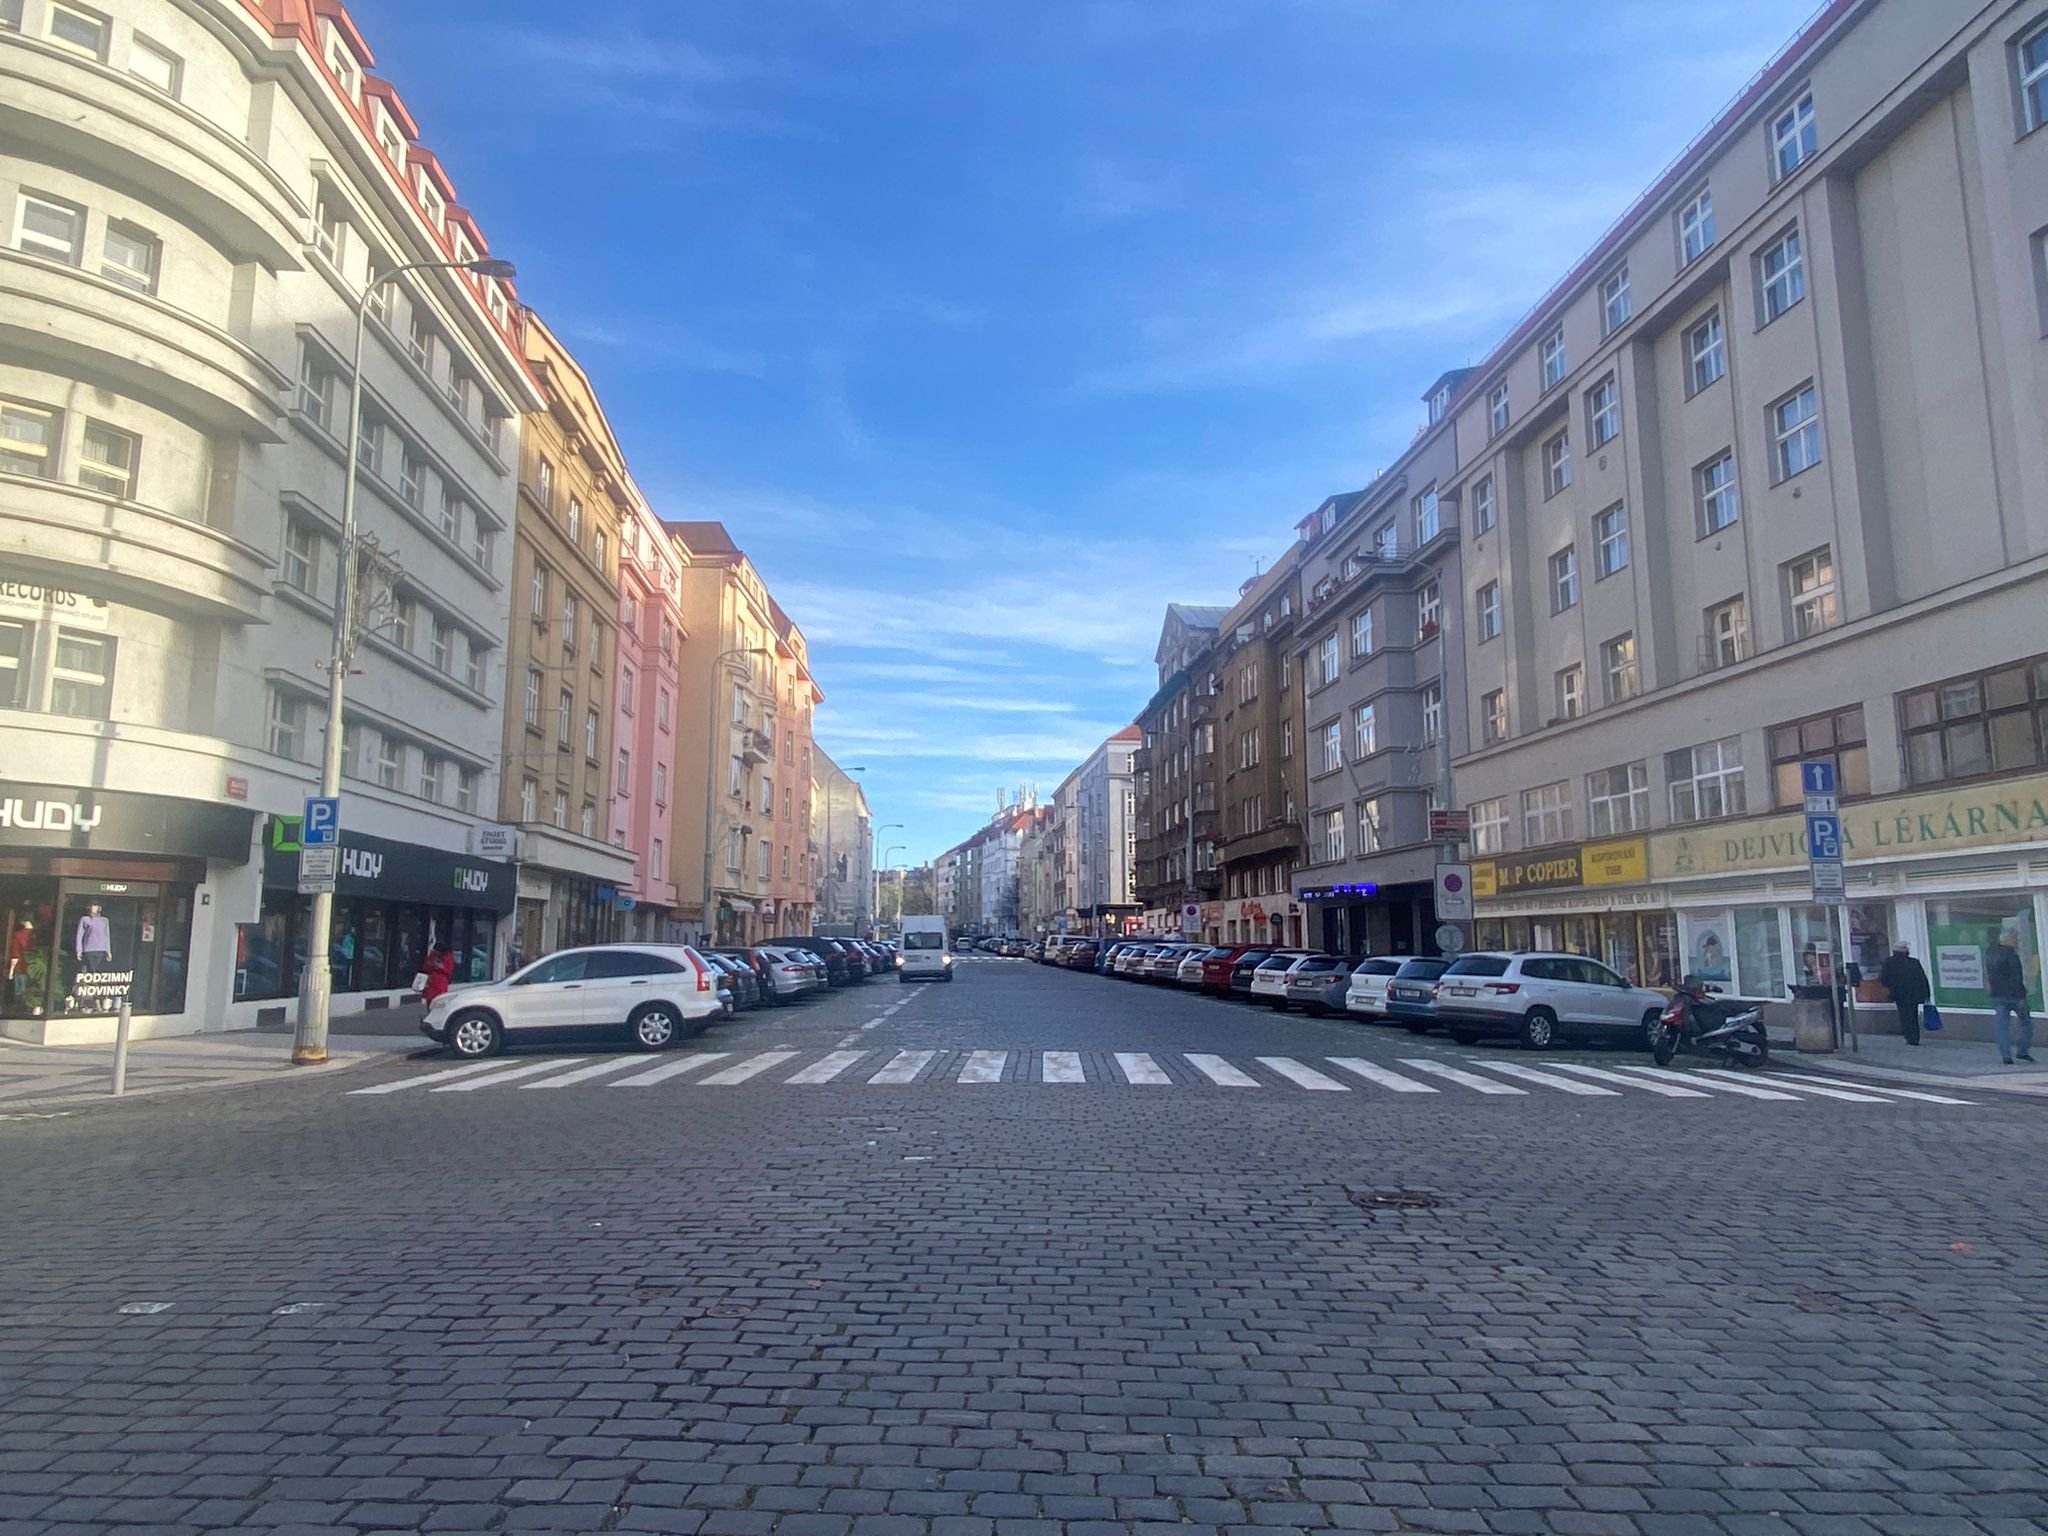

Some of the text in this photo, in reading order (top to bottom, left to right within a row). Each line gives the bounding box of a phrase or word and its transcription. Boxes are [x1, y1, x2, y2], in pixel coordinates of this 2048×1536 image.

[311, 803, 331, 831] P
[1873, 799, 2048, 846] LÉKÁRNA
[1814, 820, 1832, 846] P
[342, 848, 383, 878] HUDY
[1527, 858, 1578, 882] COPIER
[463, 868, 488, 892] HUDY
[76, 970, 134, 983] PODZIMNÍ
[78, 985, 130, 996] NOVINKY
